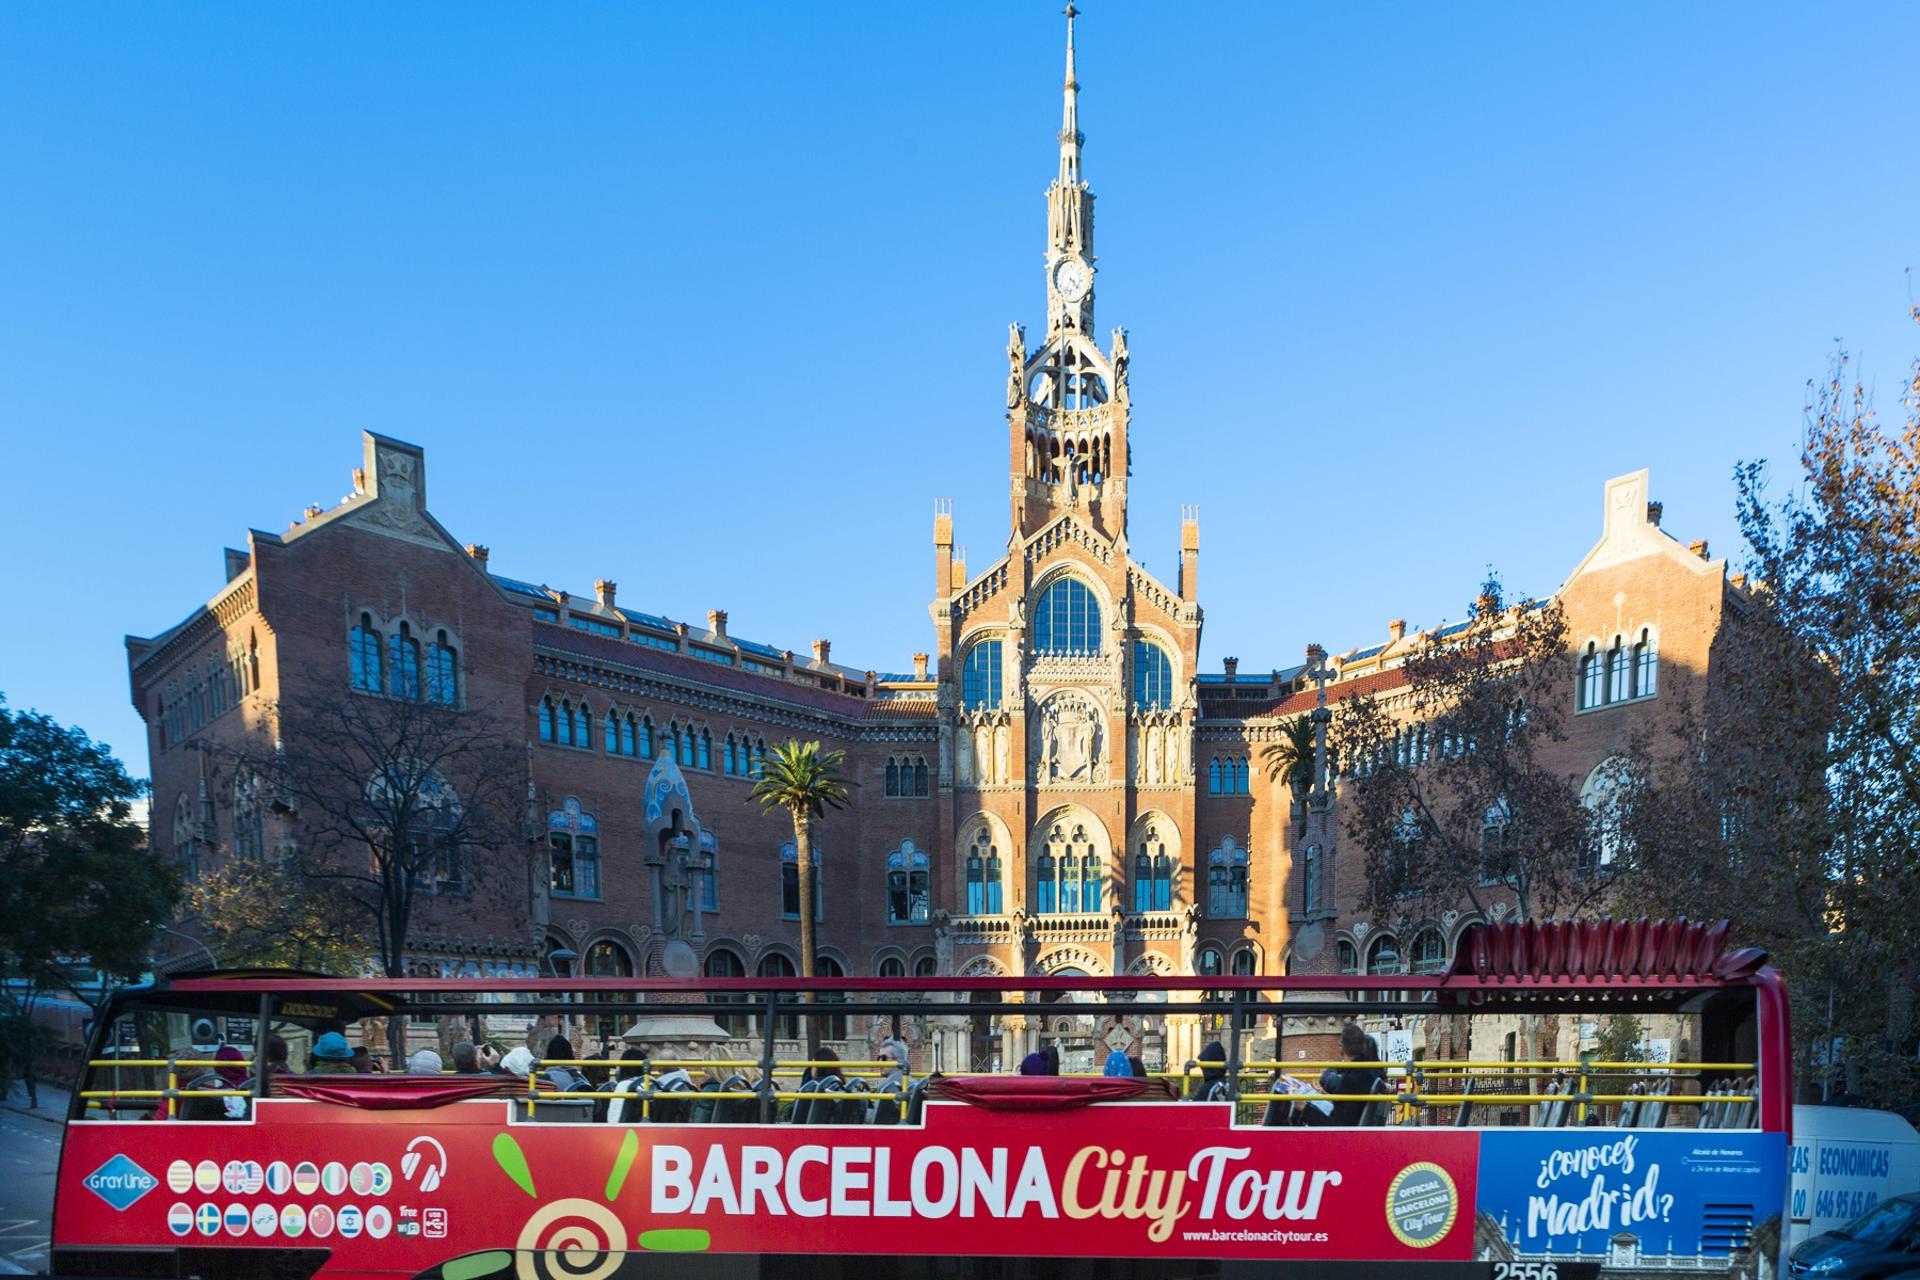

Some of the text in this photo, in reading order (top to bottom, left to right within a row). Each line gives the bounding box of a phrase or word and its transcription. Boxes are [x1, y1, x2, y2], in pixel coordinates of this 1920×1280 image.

[1820, 1147, 1889, 1178] ECONOMICAS
[651, 1144, 1059, 1219] BARCELONA
[1399, 1180, 1441, 1198] OFFICIAL
[1394, 1194, 1450, 1216] BARCELONA
[1528, 1163, 1675, 1238] Madrid?
[1816, 1189, 1834, 1218] 646
[1836, 1190, 1849, 1219] 95
[1849, 1191, 1863, 1218] 65
[1182, 1228, 1329, 1245] www.barcelonacitytour.es
[1493, 1262, 1559, 1280] 2556
